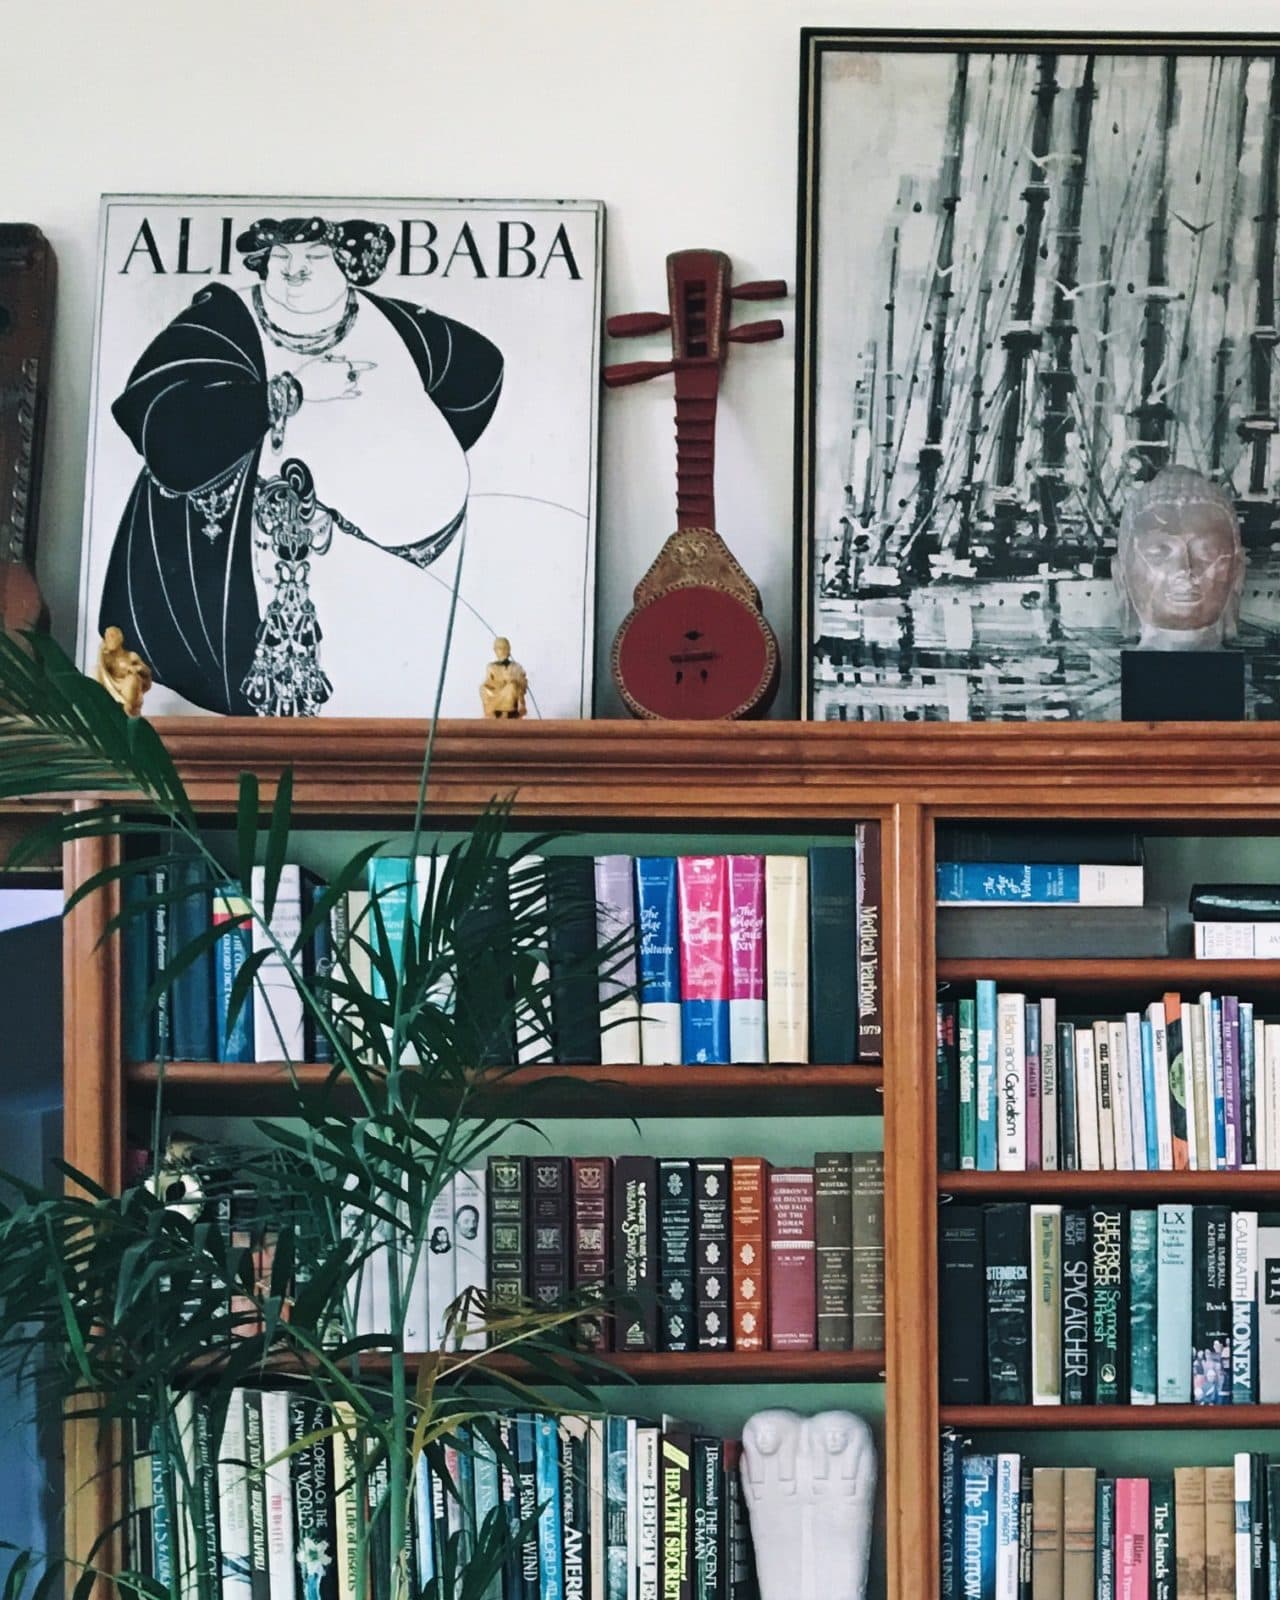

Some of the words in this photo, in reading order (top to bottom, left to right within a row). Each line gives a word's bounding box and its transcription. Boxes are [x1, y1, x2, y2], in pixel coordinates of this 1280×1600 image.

[118, 217, 233, 275] ALI
[399, 219, 582, 279] BABA
[1021, 864, 1031, 897] Voltaire
[860, 906, 878, 956] Medical
[860, 958, 878, 1017] Yearbook
[1002, 1014, 1020, 1045] Islam
[1156, 1029, 1165, 1052] Islam
[1002, 1048, 1020, 1071] and
[1043, 1043, 1054, 1096] PAKISTAN
[1002, 1073, 1020, 1136] Capitalism
[1064, 1215, 1075, 1246] WRIGHT
[1075, 1218, 1086, 1242] PETER
[1093, 1211, 1107, 1233] OF
[1107, 1212, 1120, 1240] THE
[1163, 1212, 1185, 1225] LX
[1218, 1222, 1227, 1242] THE
[1093, 1234, 1107, 1286] POWER
[1107, 1242, 1120, 1285] PRICE
[1207, 1221, 1217, 1288] ACHIEVEMENT
[1218, 1246, 1227, 1288] IMPERIAL
[1235, 1219, 1250, 1298] GALBRAITH
[1064, 1261, 1088, 1377] SPYCATCHER
[1105, 1290, 1121, 1350] Seymour
[1232, 1302, 1253, 1388] MONEY
[665, 1467, 681, 1535] HEALTH
[963, 1477, 989, 1507] The
[695, 1508, 705, 1533] OF
[705, 1508, 717, 1537] THE
[1155, 1503, 1169, 1531] The
[522, 1541, 538, 1581] WIND
[544, 1528, 557, 1576] WORLD
[695, 1534, 705, 1560] MAN
[705, 1538, 717, 1588] ASCENT
[963, 1511, 989, 1597] Tomorrow
[1155, 1533, 1169, 1579] Islands
